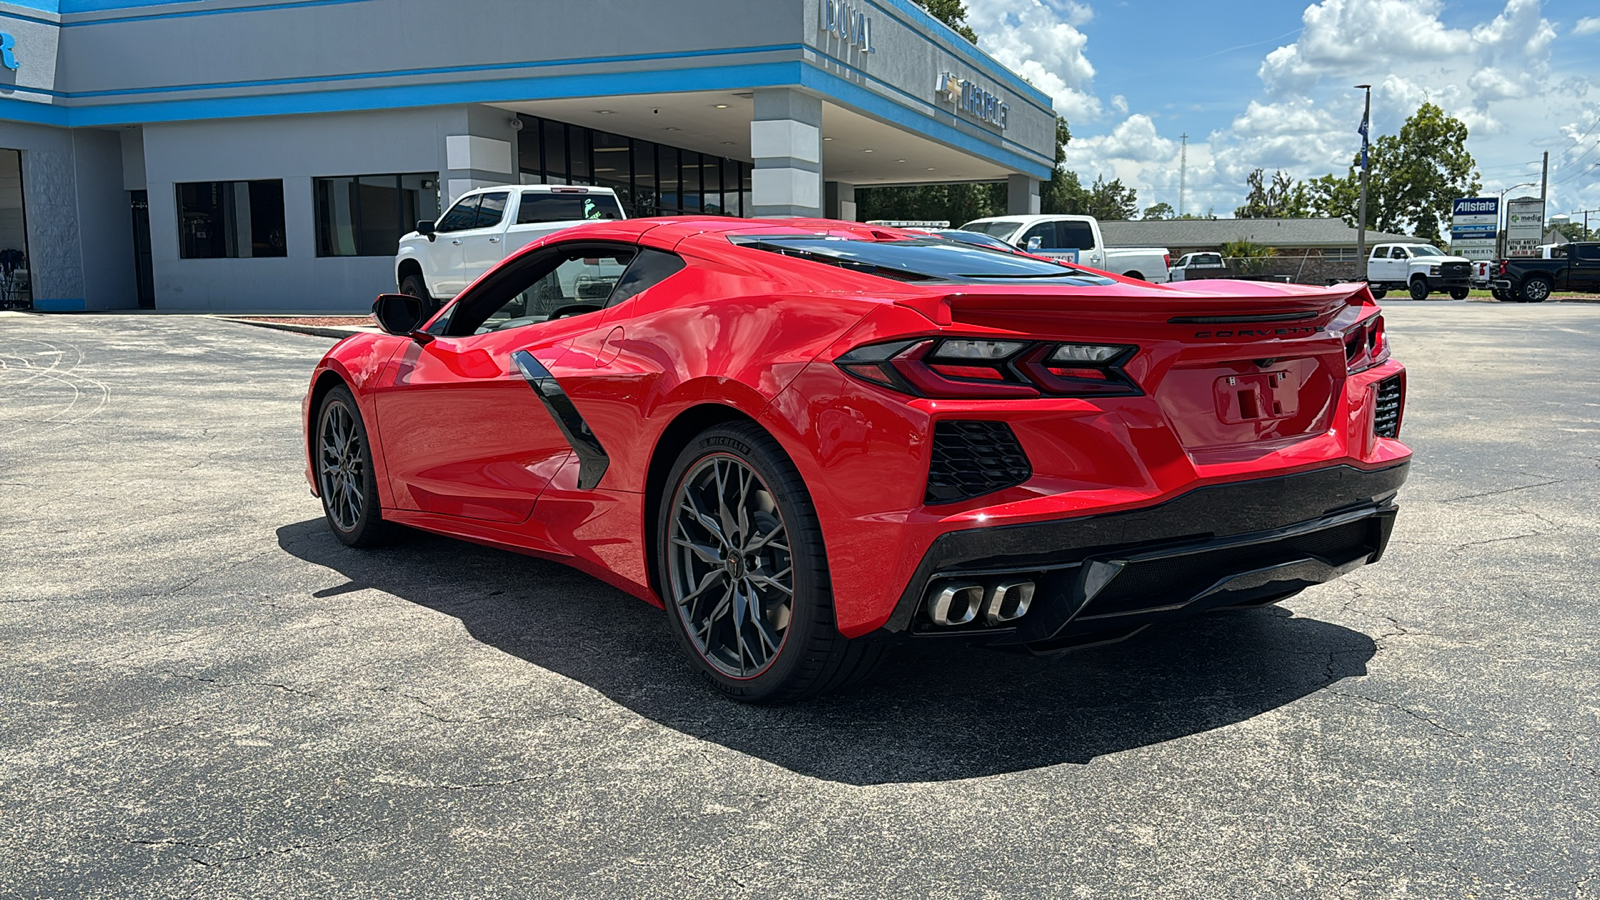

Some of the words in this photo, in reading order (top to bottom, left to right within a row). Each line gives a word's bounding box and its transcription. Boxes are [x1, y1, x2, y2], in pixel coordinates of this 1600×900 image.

[820, 0, 875, 54] DUVAL
[959, 79, 1010, 130] CHEVROLET
[1455, 202, 1496, 212] Allstate
[1194, 326, 1326, 339] CORVETTE
[709, 436, 750, 454] MICHELIN
